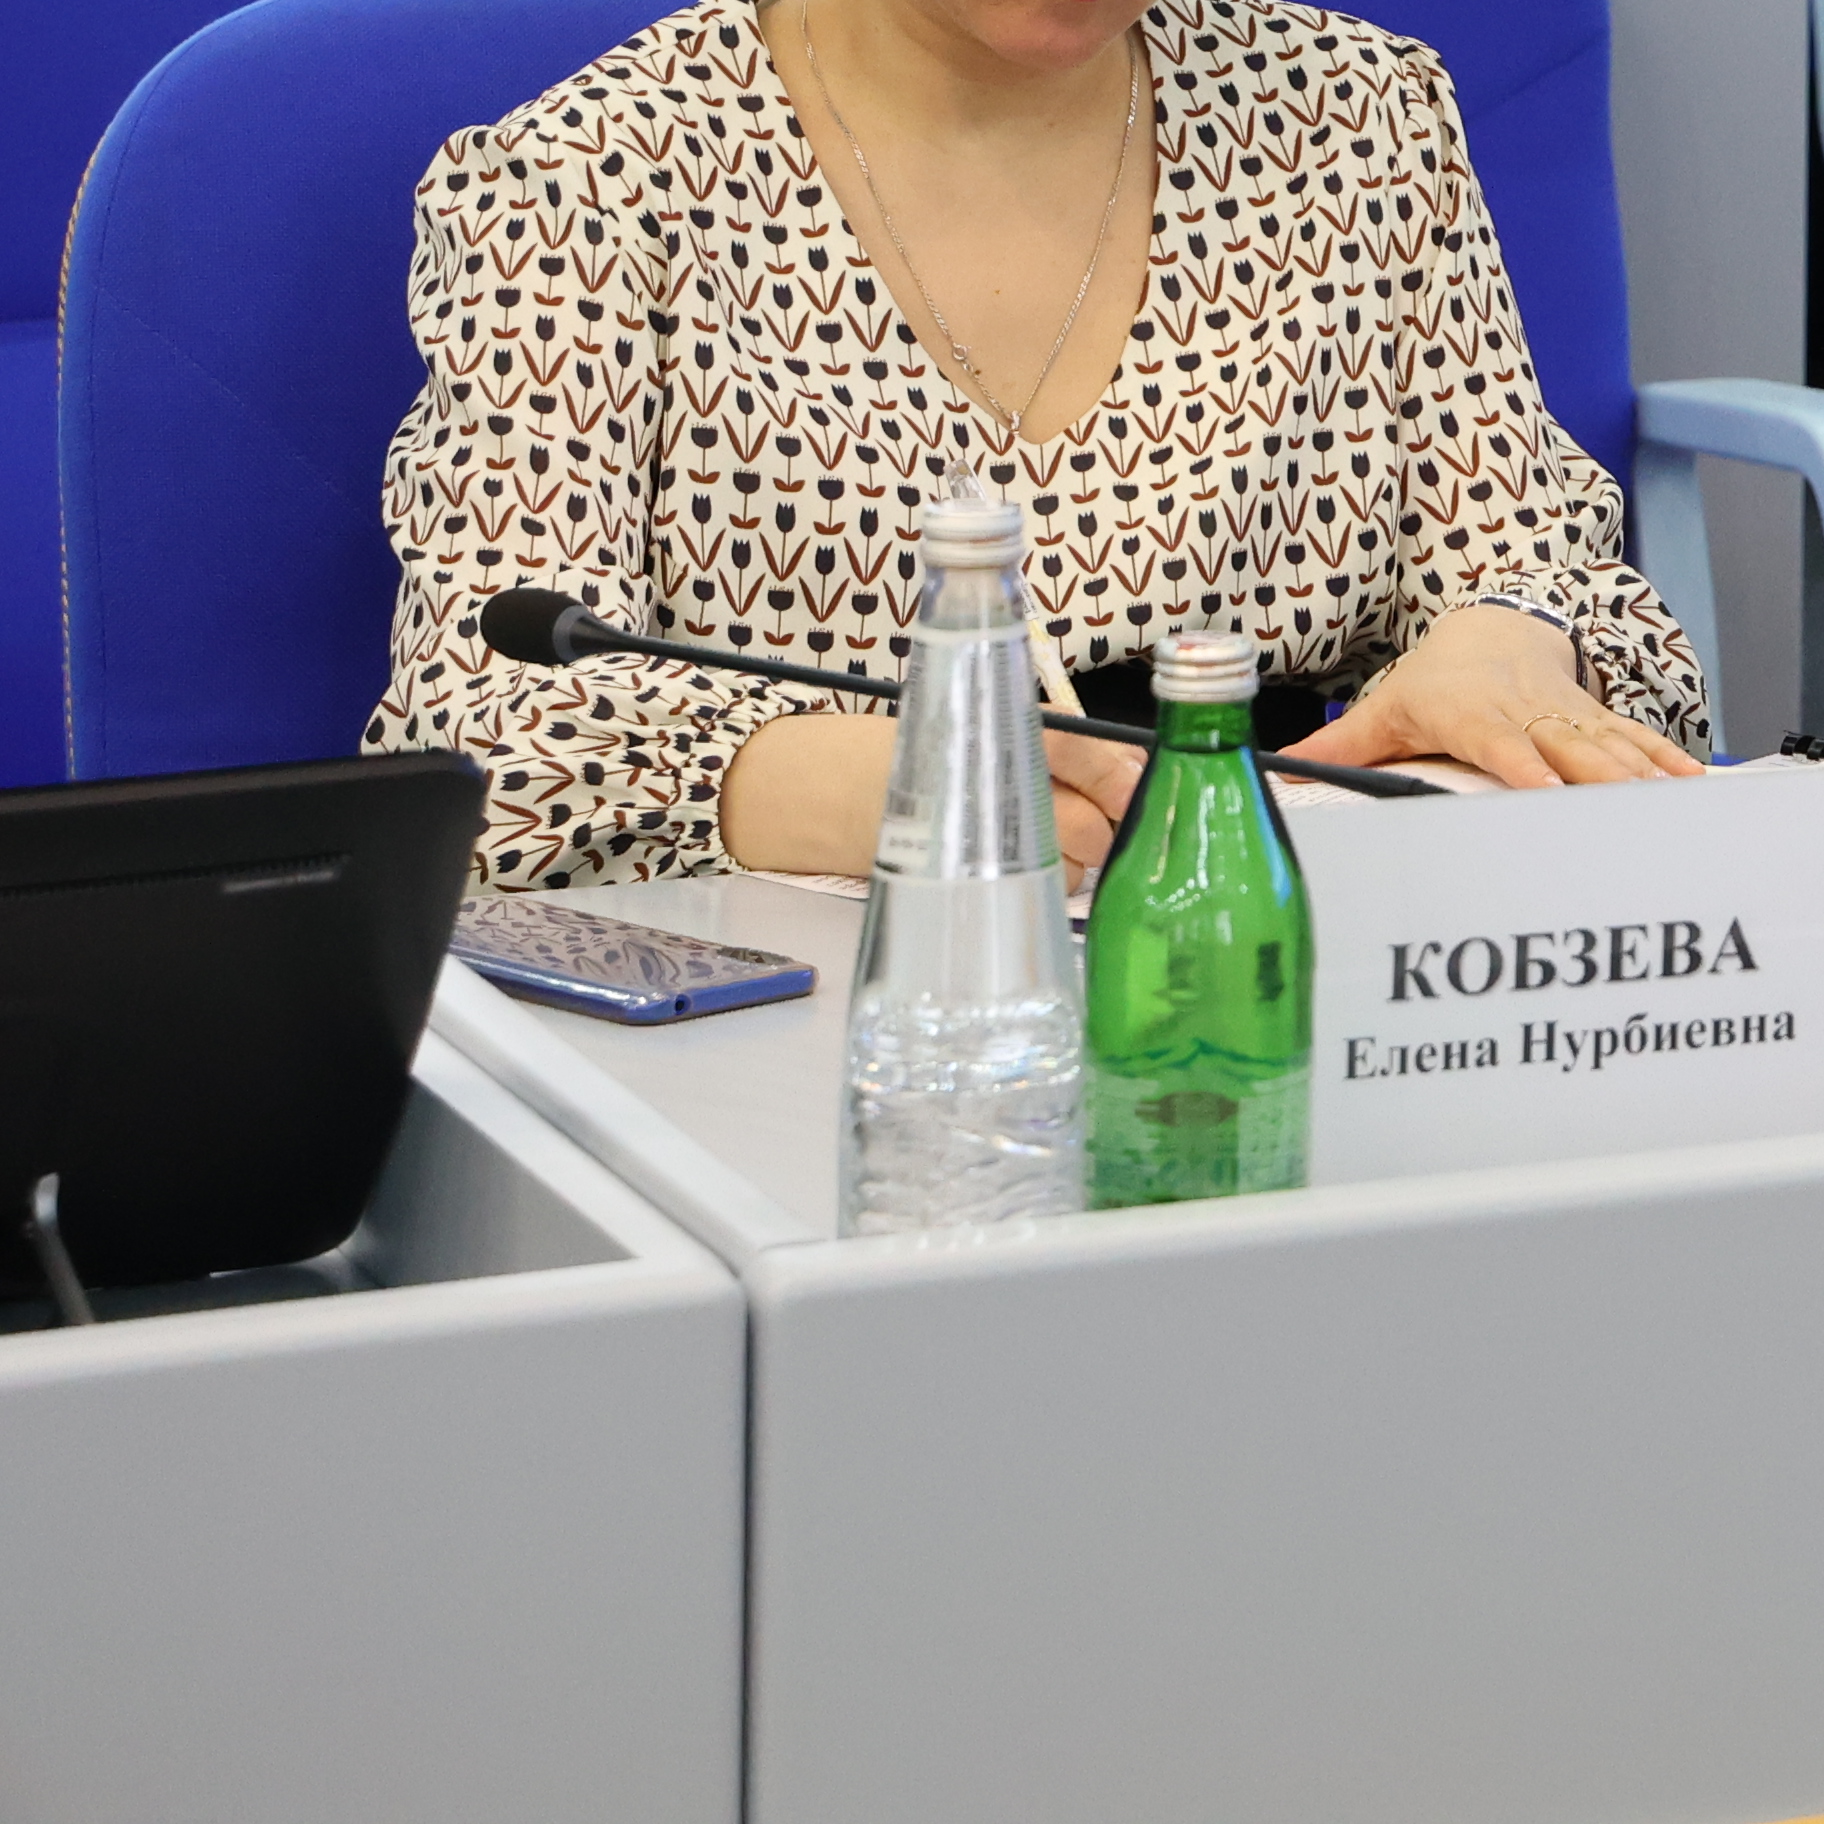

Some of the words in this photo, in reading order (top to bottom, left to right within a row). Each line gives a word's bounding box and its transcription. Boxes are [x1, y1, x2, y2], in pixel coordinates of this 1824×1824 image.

[1386, 916, 1758, 1003] КОБЗЕВА
[1343, 1035, 1499, 1080] Елена
[1519, 1010, 1796, 1071] Нурбиевна
